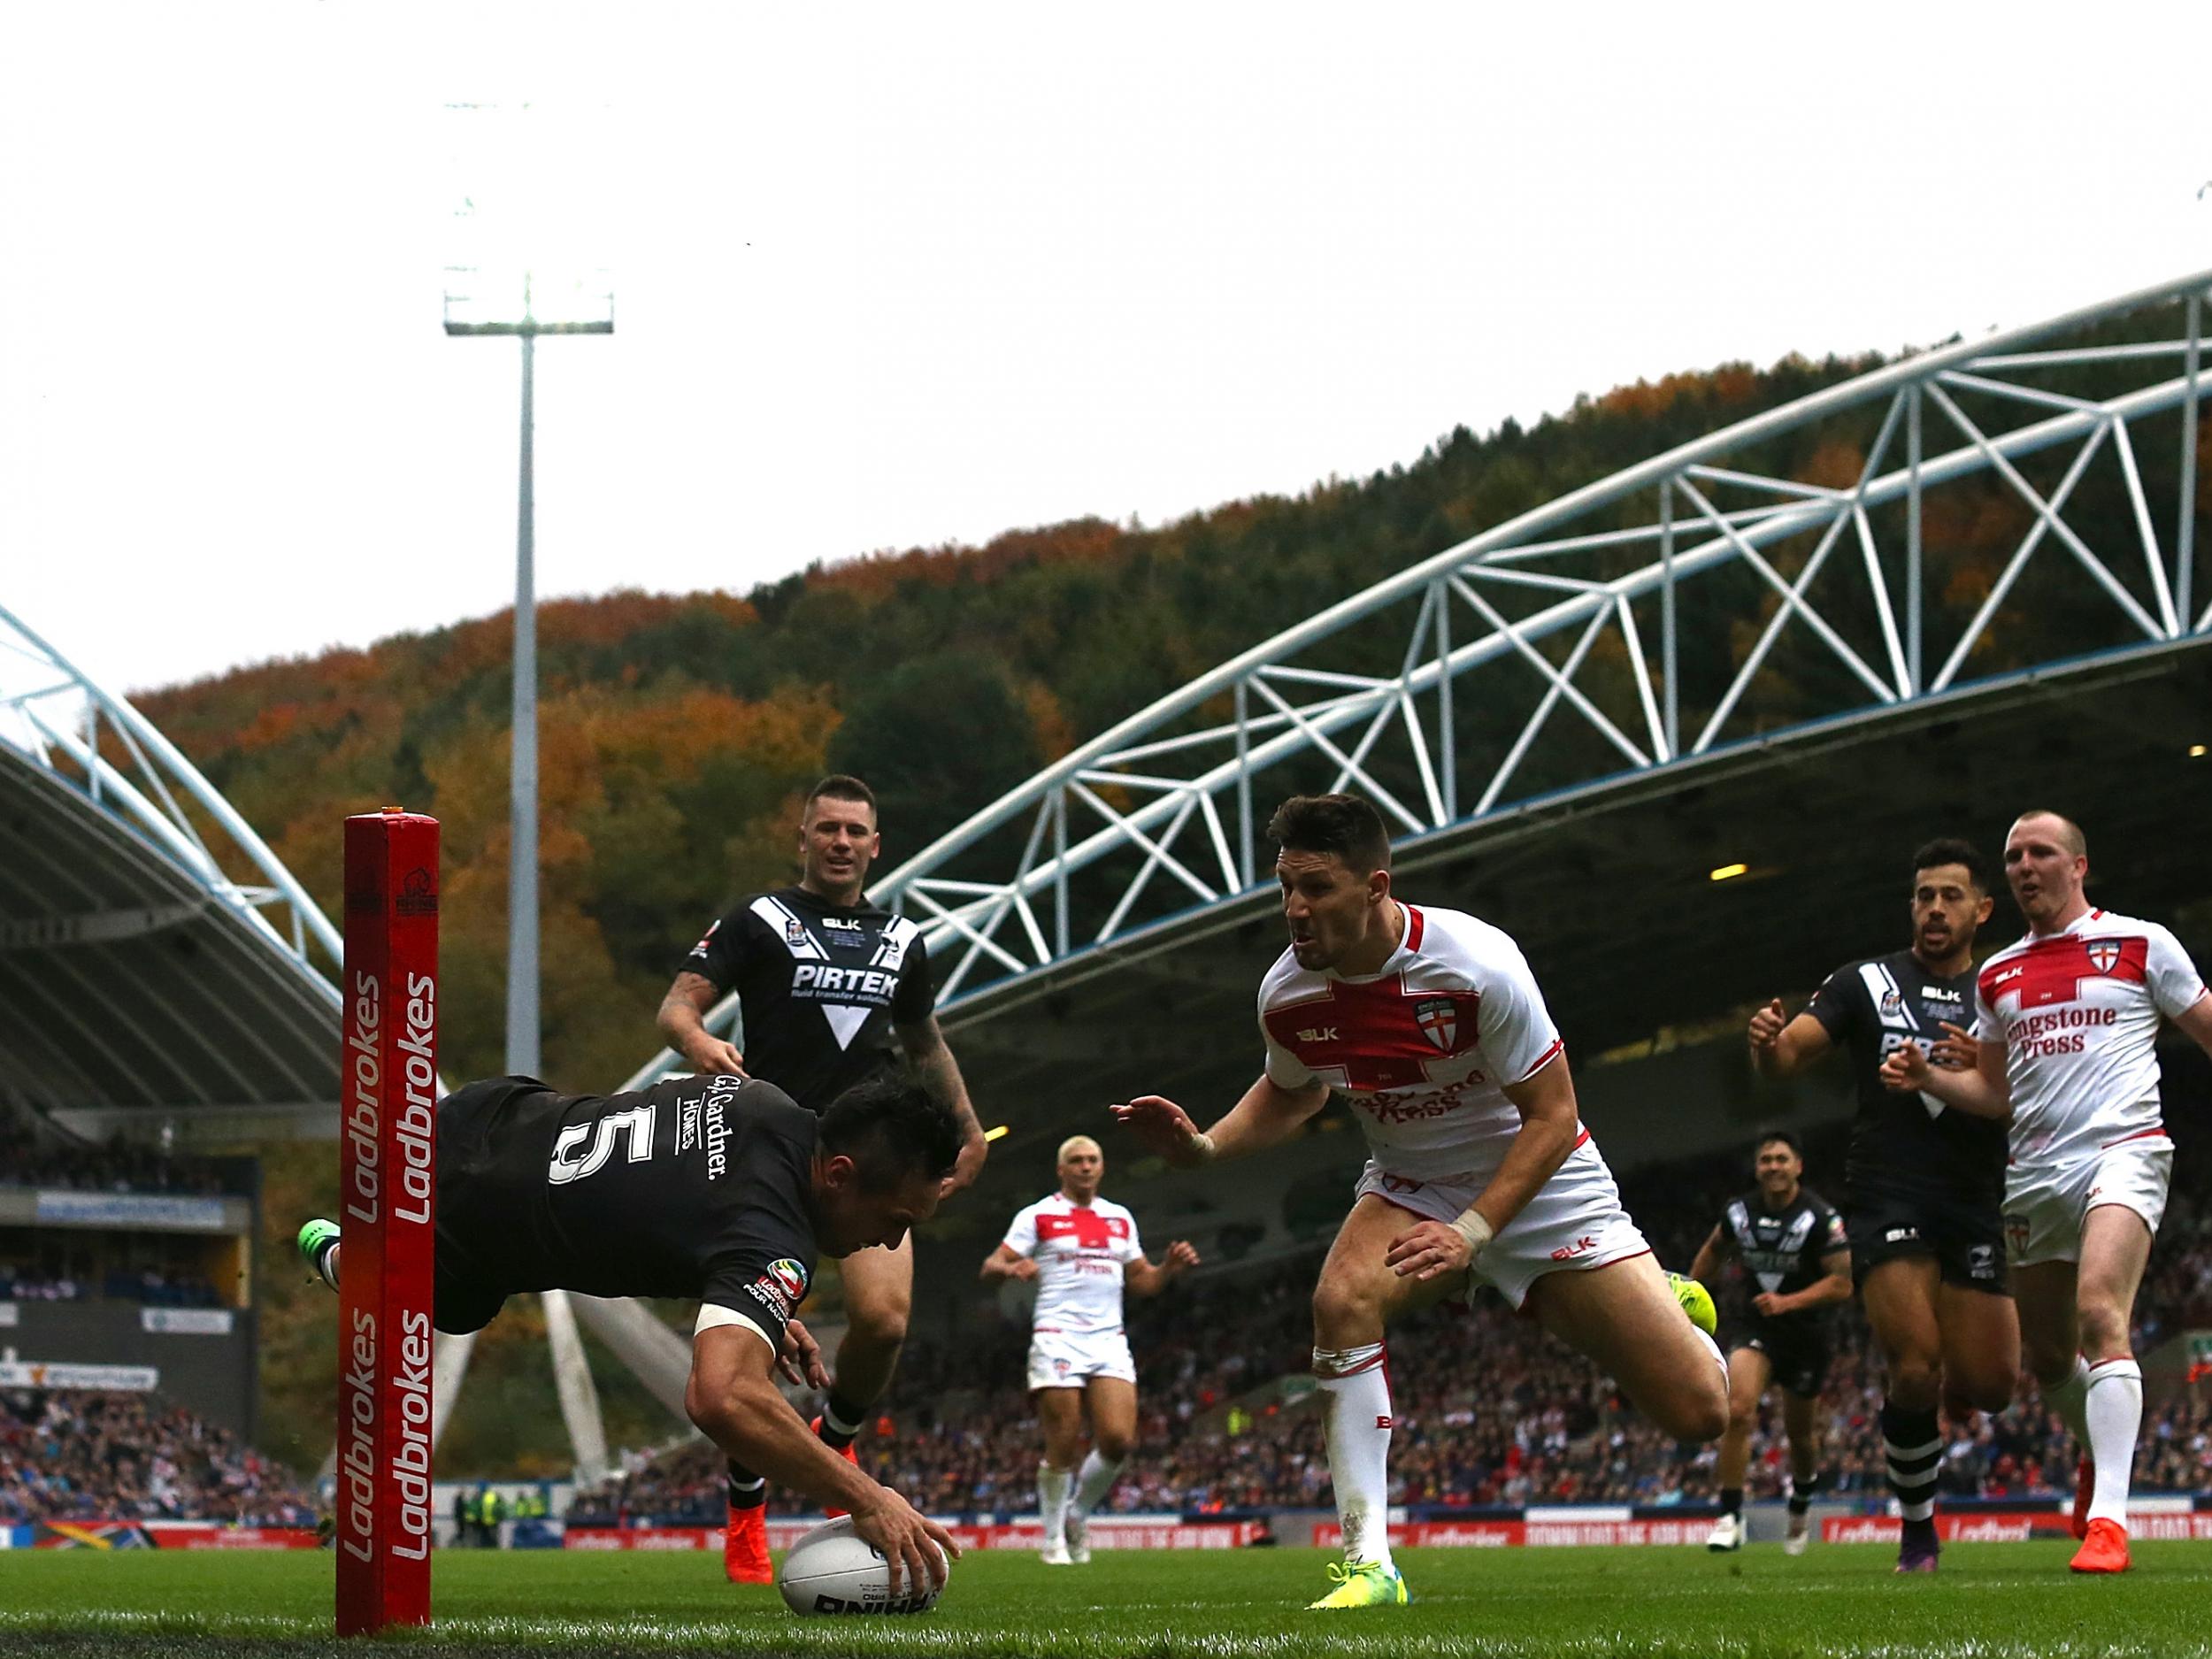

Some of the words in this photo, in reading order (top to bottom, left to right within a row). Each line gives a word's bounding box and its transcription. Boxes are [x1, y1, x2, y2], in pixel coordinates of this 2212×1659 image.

[792, 964, 900, 999] PIRTEK
[1921, 986, 1962, 1002] BLK
[1296, 1026, 1340, 1042] BLK
[2021, 1033, 2085, 1061] Press
[347, 970, 380, 1225] Ladbrokes
[395, 972, 435, 1225] Ladbrokes
[681, 1099, 700, 1151] HOMES
[548, 1104, 657, 1186] 5
[1551, 1236, 1597, 1261] BLK
[743, 1283, 768, 1305] FOUR
[343, 1307, 376, 1563] Ladbrokes
[392, 1309, 430, 1562] Ladbrokes
[813, 1594, 928, 1617] RHINO
